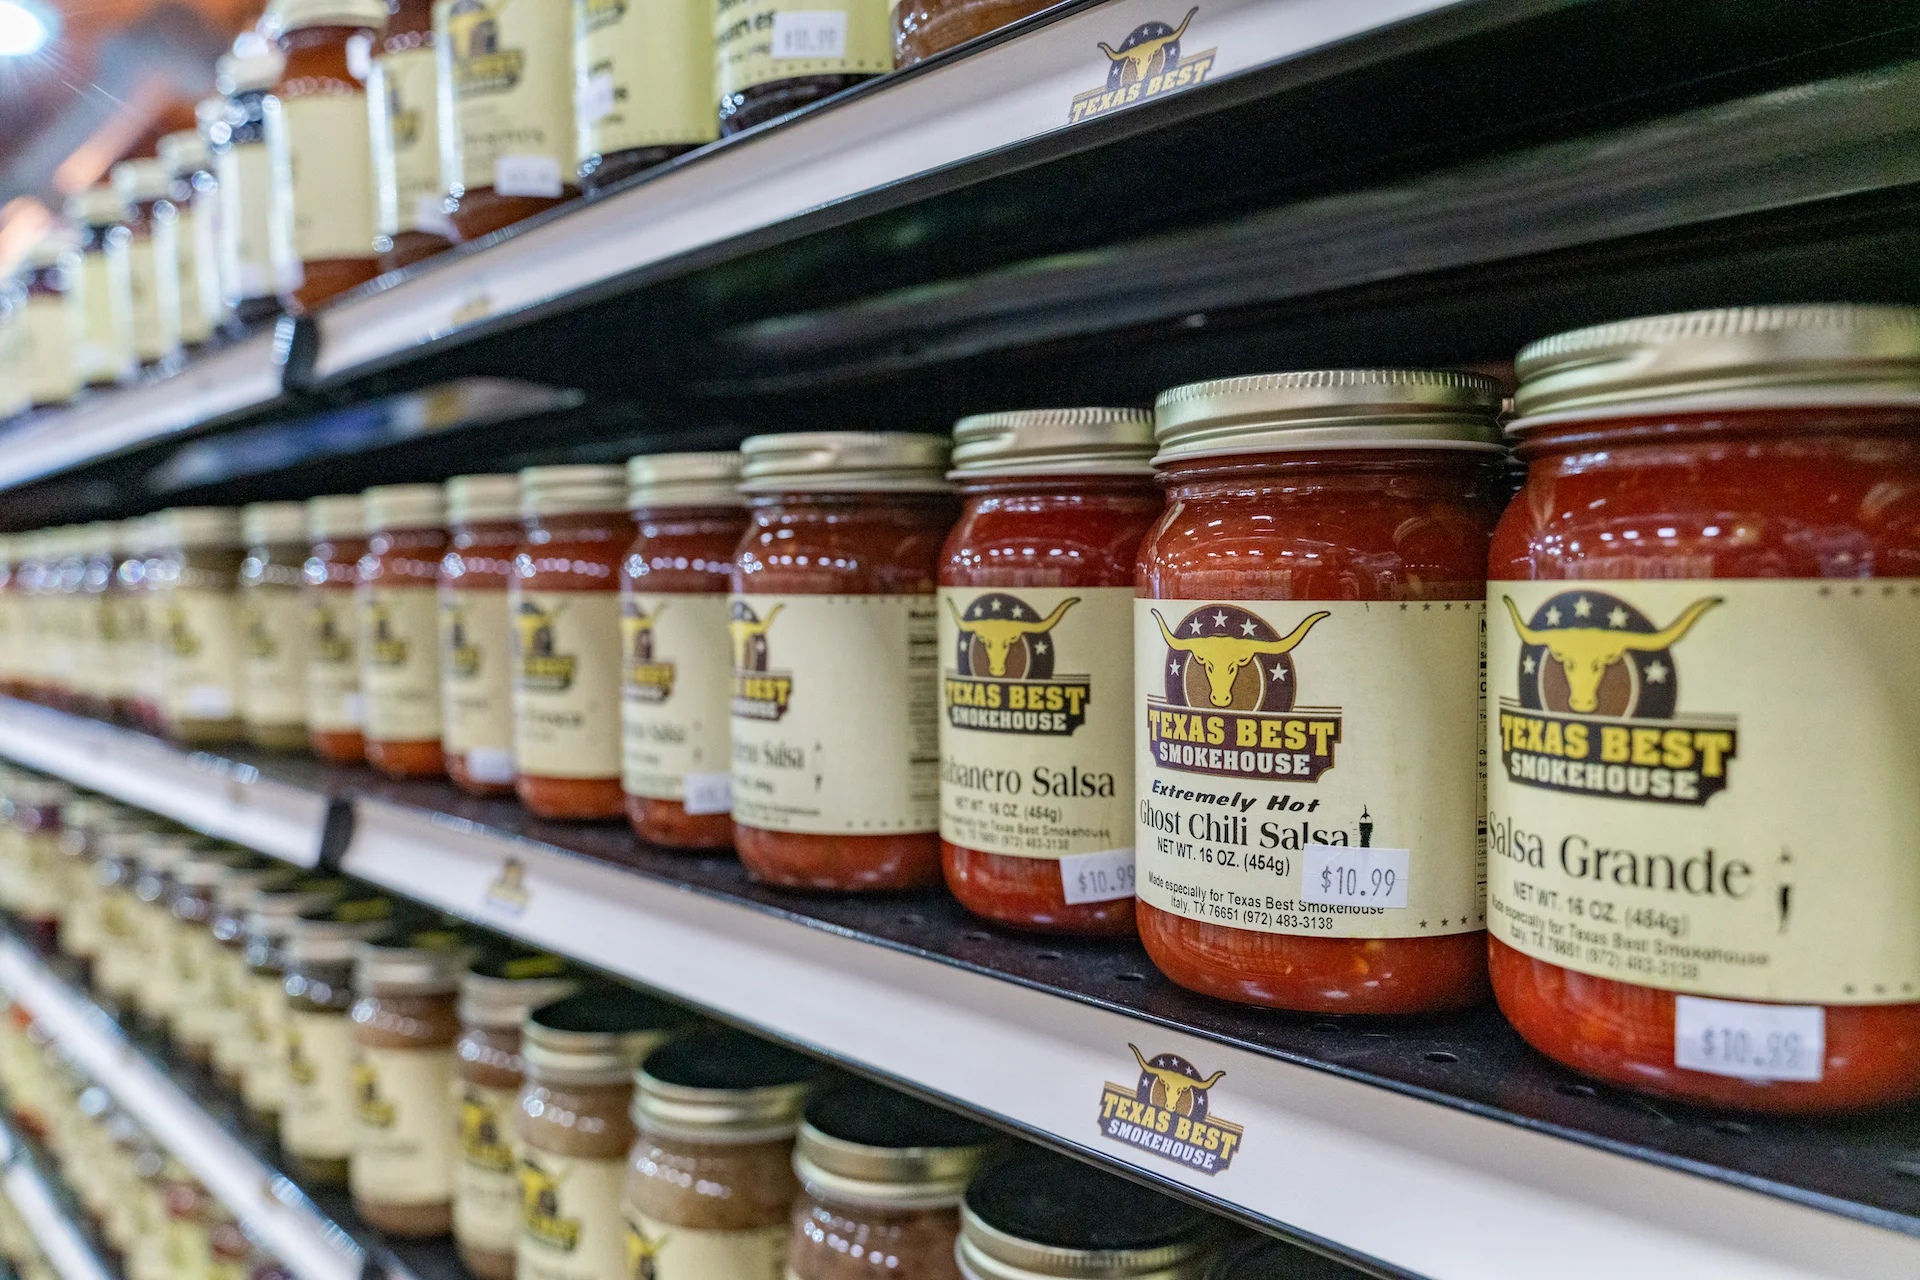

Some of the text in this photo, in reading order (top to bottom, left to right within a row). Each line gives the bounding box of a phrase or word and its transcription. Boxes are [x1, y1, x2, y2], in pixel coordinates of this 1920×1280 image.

[1072, 58, 1211, 123] TEXAS BEST
[945, 681, 1086, 715] TEXAS BEST
[952, 706, 1068, 732] SMOKEHOUSE
[1150, 709, 1335, 757] TEXAS BEST
[1159, 742, 1310, 775] SMOKEHOUSE
[1501, 714, 1733, 777] TEXAS BEST
[1032, 765, 1116, 798] Salsa
[1152, 779, 1320, 813] Extremely Hot
[1510, 751, 1699, 800] SMOKEHOUSE
[1140, 799, 1349, 851] Ghost Chili Salsa
[1158, 836, 1290, 877] NET WT. 16 OZ. (454g)
[1488, 810, 1754, 899] Salsa Grande
[1078, 863, 1136, 895] $10.99
[1148, 871, 1164, 888] Made
[1165, 880, 1207, 902] especially
[1209, 888, 1223, 902] for
[1227, 892, 1261, 908] Texas
[1265, 896, 1294, 911] Best
[1321, 865, 1396, 897] $10.99
[1194, 900, 1206, 915] TX
[1209, 904, 1238, 921] 76651
[1243, 910, 1272, 928] (972)
[1276, 914, 1333, 930] 483-3138
[1513, 880, 1534, 902] NET
[1625, 905, 1690, 938] (454g)
[1103, 1092, 1237, 1160] TEXAS BEST
[1108, 1119, 1217, 1170] SMOKEHOUSE
